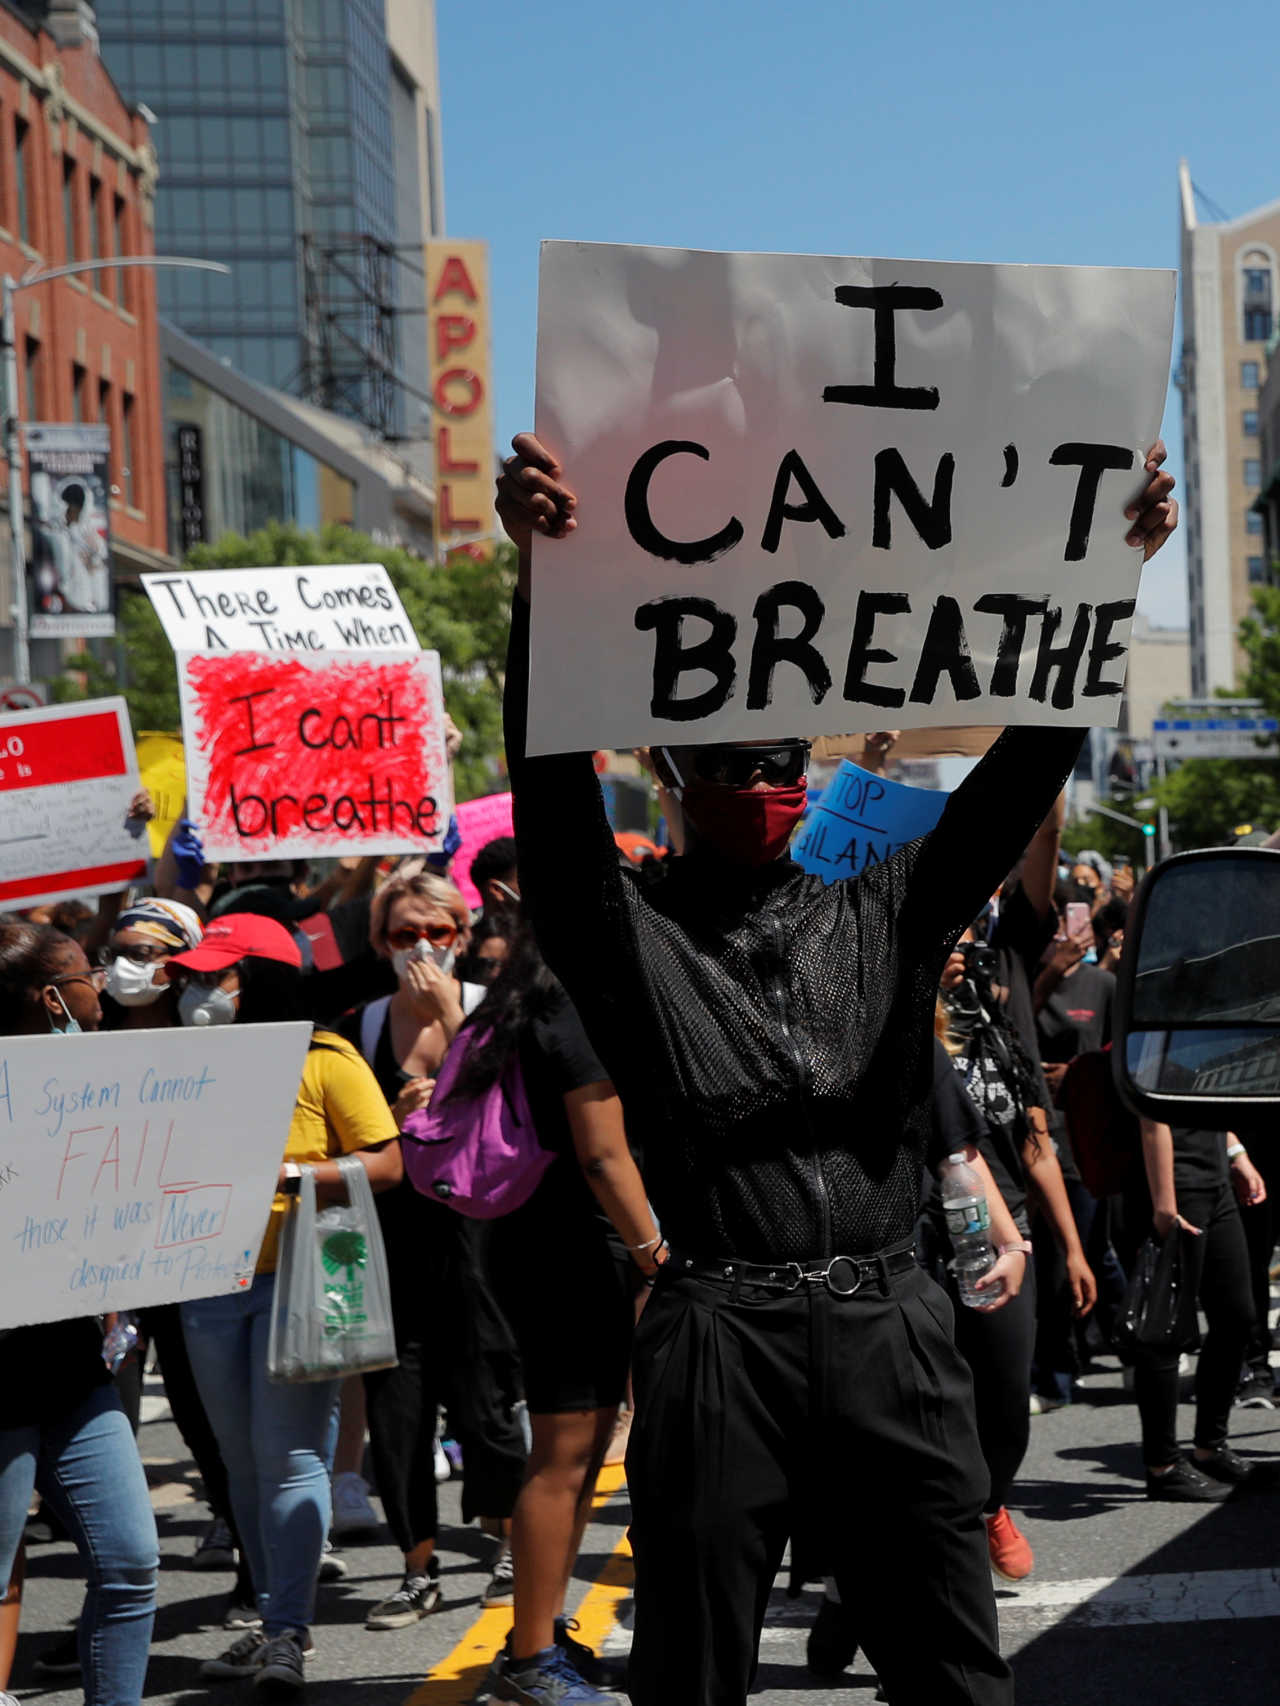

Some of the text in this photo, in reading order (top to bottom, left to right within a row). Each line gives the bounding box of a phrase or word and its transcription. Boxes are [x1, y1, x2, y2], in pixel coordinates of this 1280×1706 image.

[823, 281, 944, 411] I
[624, 440, 1135, 565] CAN'T
[297, 577, 393, 611] Comes
[333, 617, 408, 647] When
[634, 580, 1137, 722] BREATHE
[230, 687, 406, 756] I can't
[231, 775, 441, 838] breathe
[828, 771, 886, 817] TOP
[34, 1077, 121, 1138] System
[139, 1065, 217, 1105] Cannot
[57, 1120, 200, 1201] FAIL
[12, 1194, 223, 1254] those it was Never
[69, 1248, 146, 1299] designed
[150, 1249, 174, 1277] to
